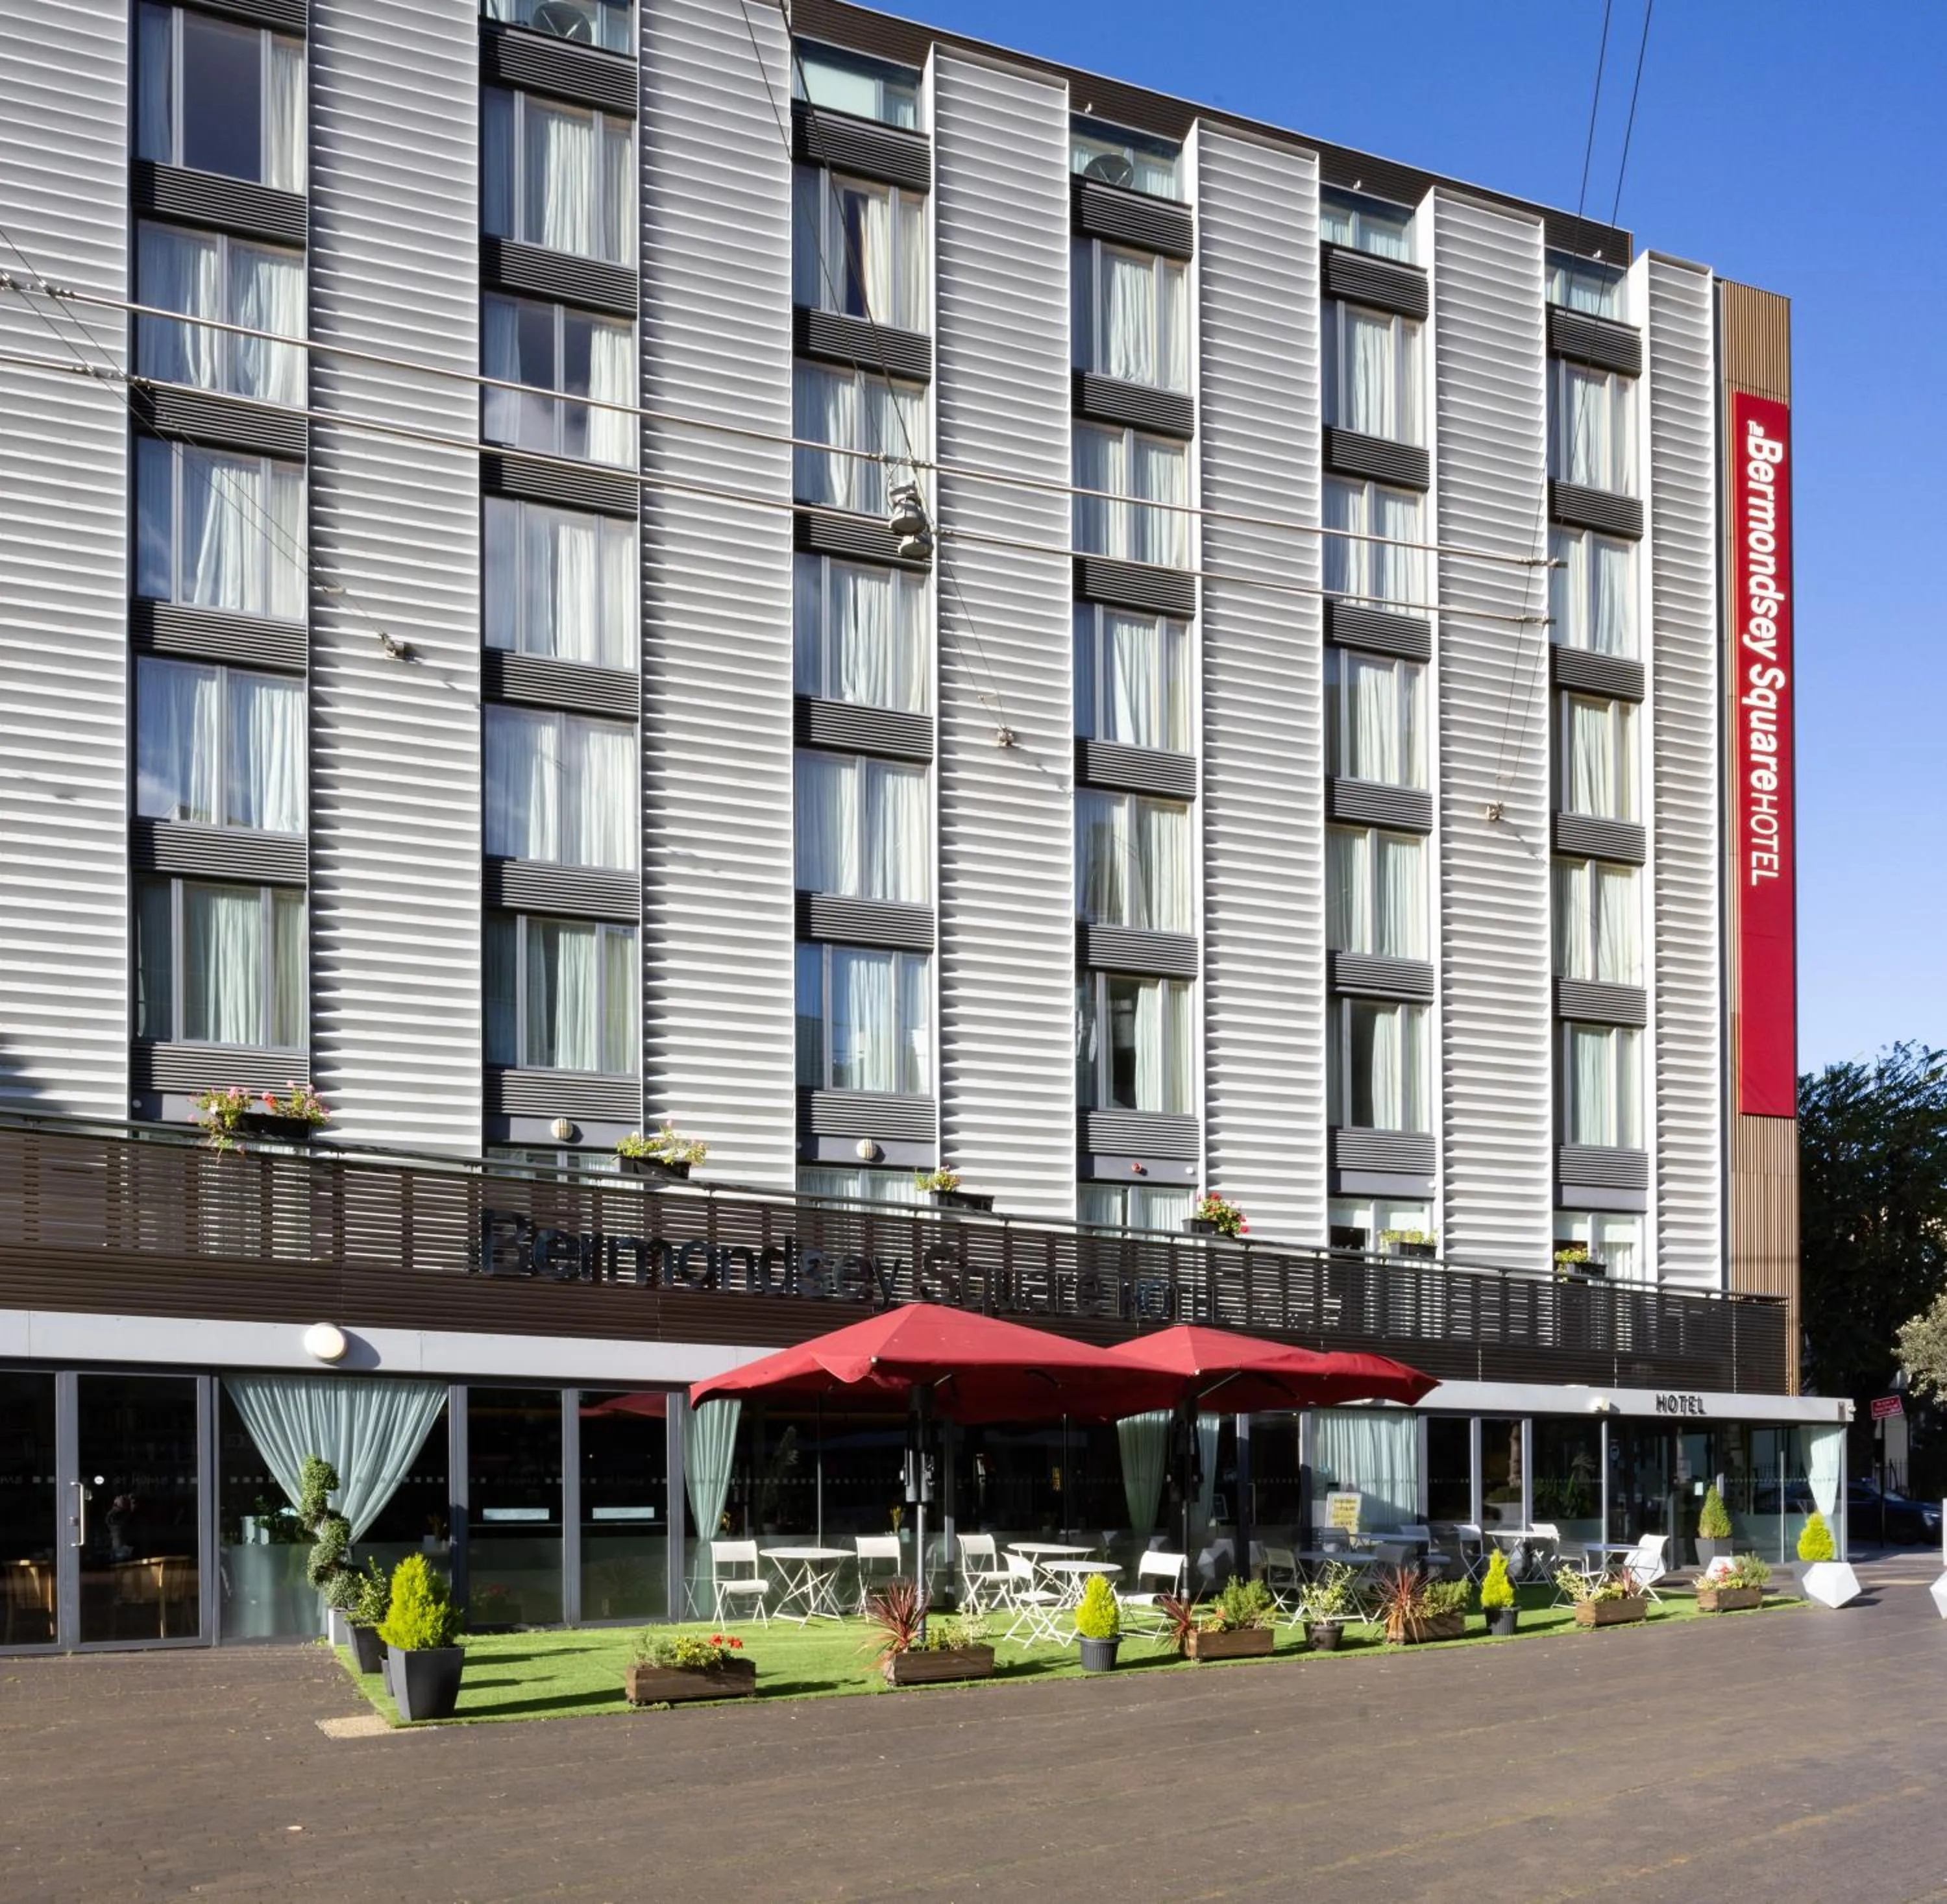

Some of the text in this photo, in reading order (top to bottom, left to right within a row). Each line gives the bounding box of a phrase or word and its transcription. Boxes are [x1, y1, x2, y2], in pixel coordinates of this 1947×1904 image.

[1742, 435, 1785, 661] Bermondsey
[481, 1208, 902, 1312] Bermondsey
[1656, 1393, 1706, 1415] HOTEL
